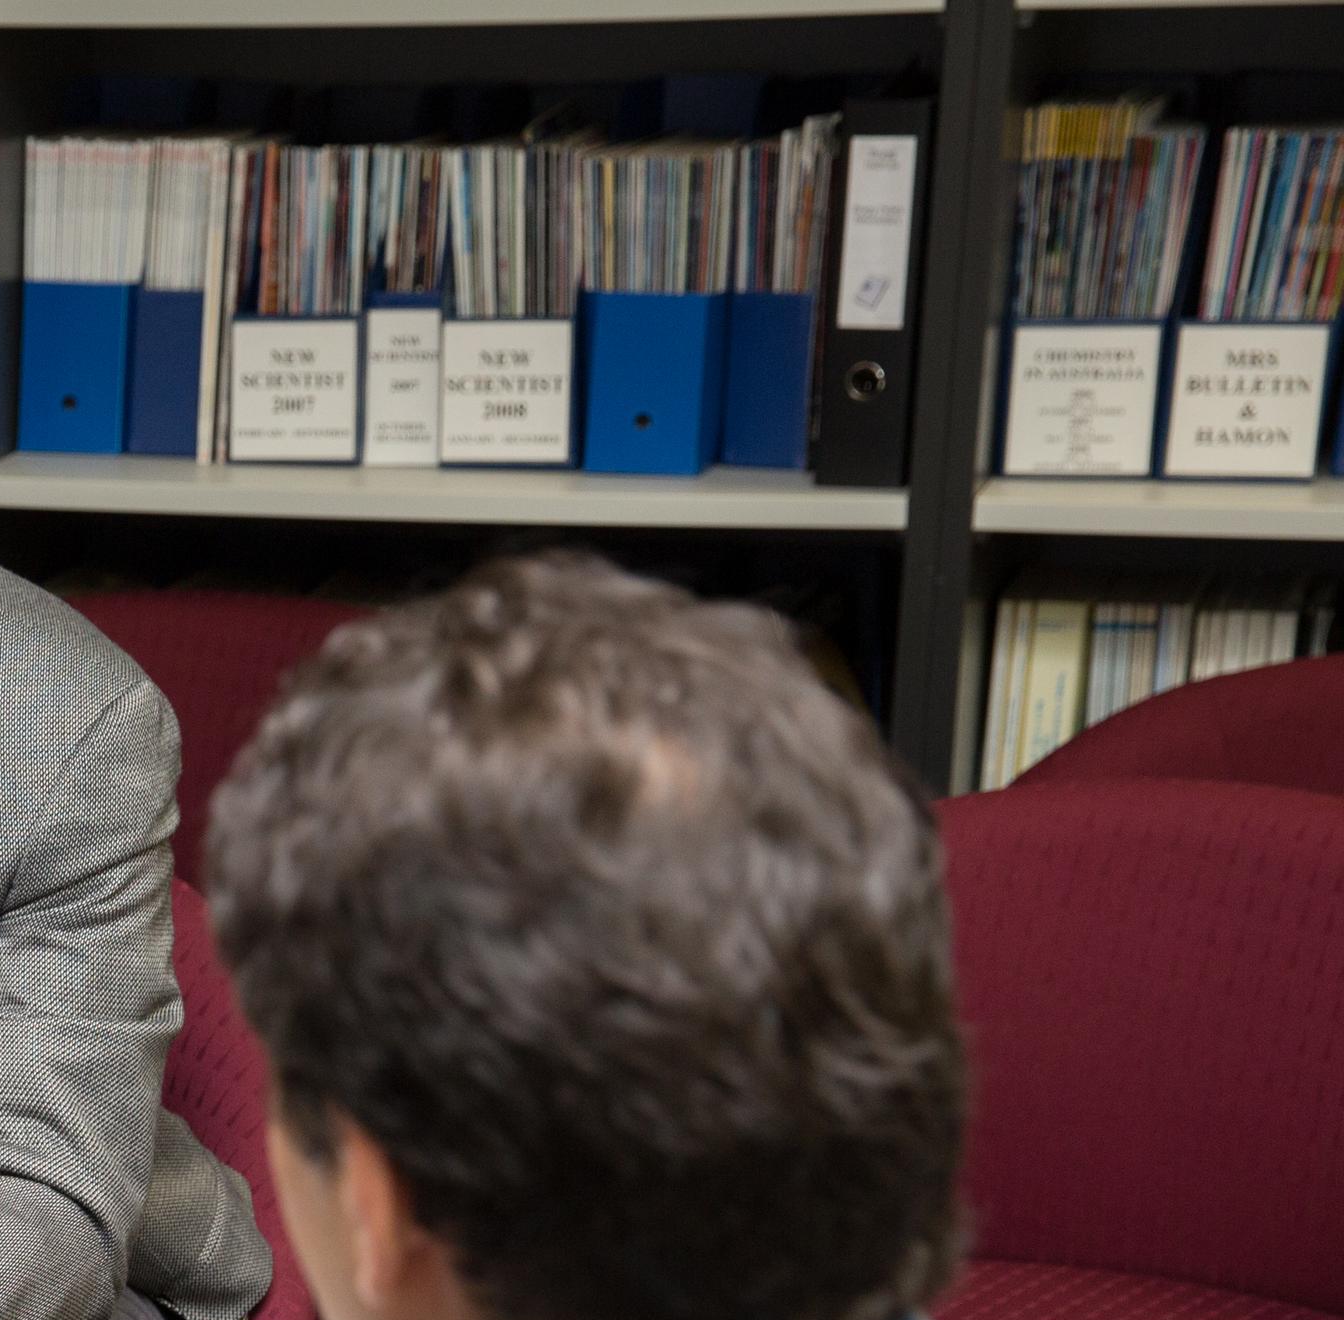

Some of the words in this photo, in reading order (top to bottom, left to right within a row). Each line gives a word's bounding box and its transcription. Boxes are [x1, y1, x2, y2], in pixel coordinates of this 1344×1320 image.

[271, 349, 316, 364] NEW
[479, 350, 531, 367] NEW
[1225, 349, 1280, 368] MRS
[240, 371, 345, 389] SCIENTIST
[447, 374, 564, 393] SCIENTIST
[1185, 375, 1312, 395] BULLETIN
[272, 395, 317, 414] 2007
[1239, 403, 1256, 420] &
